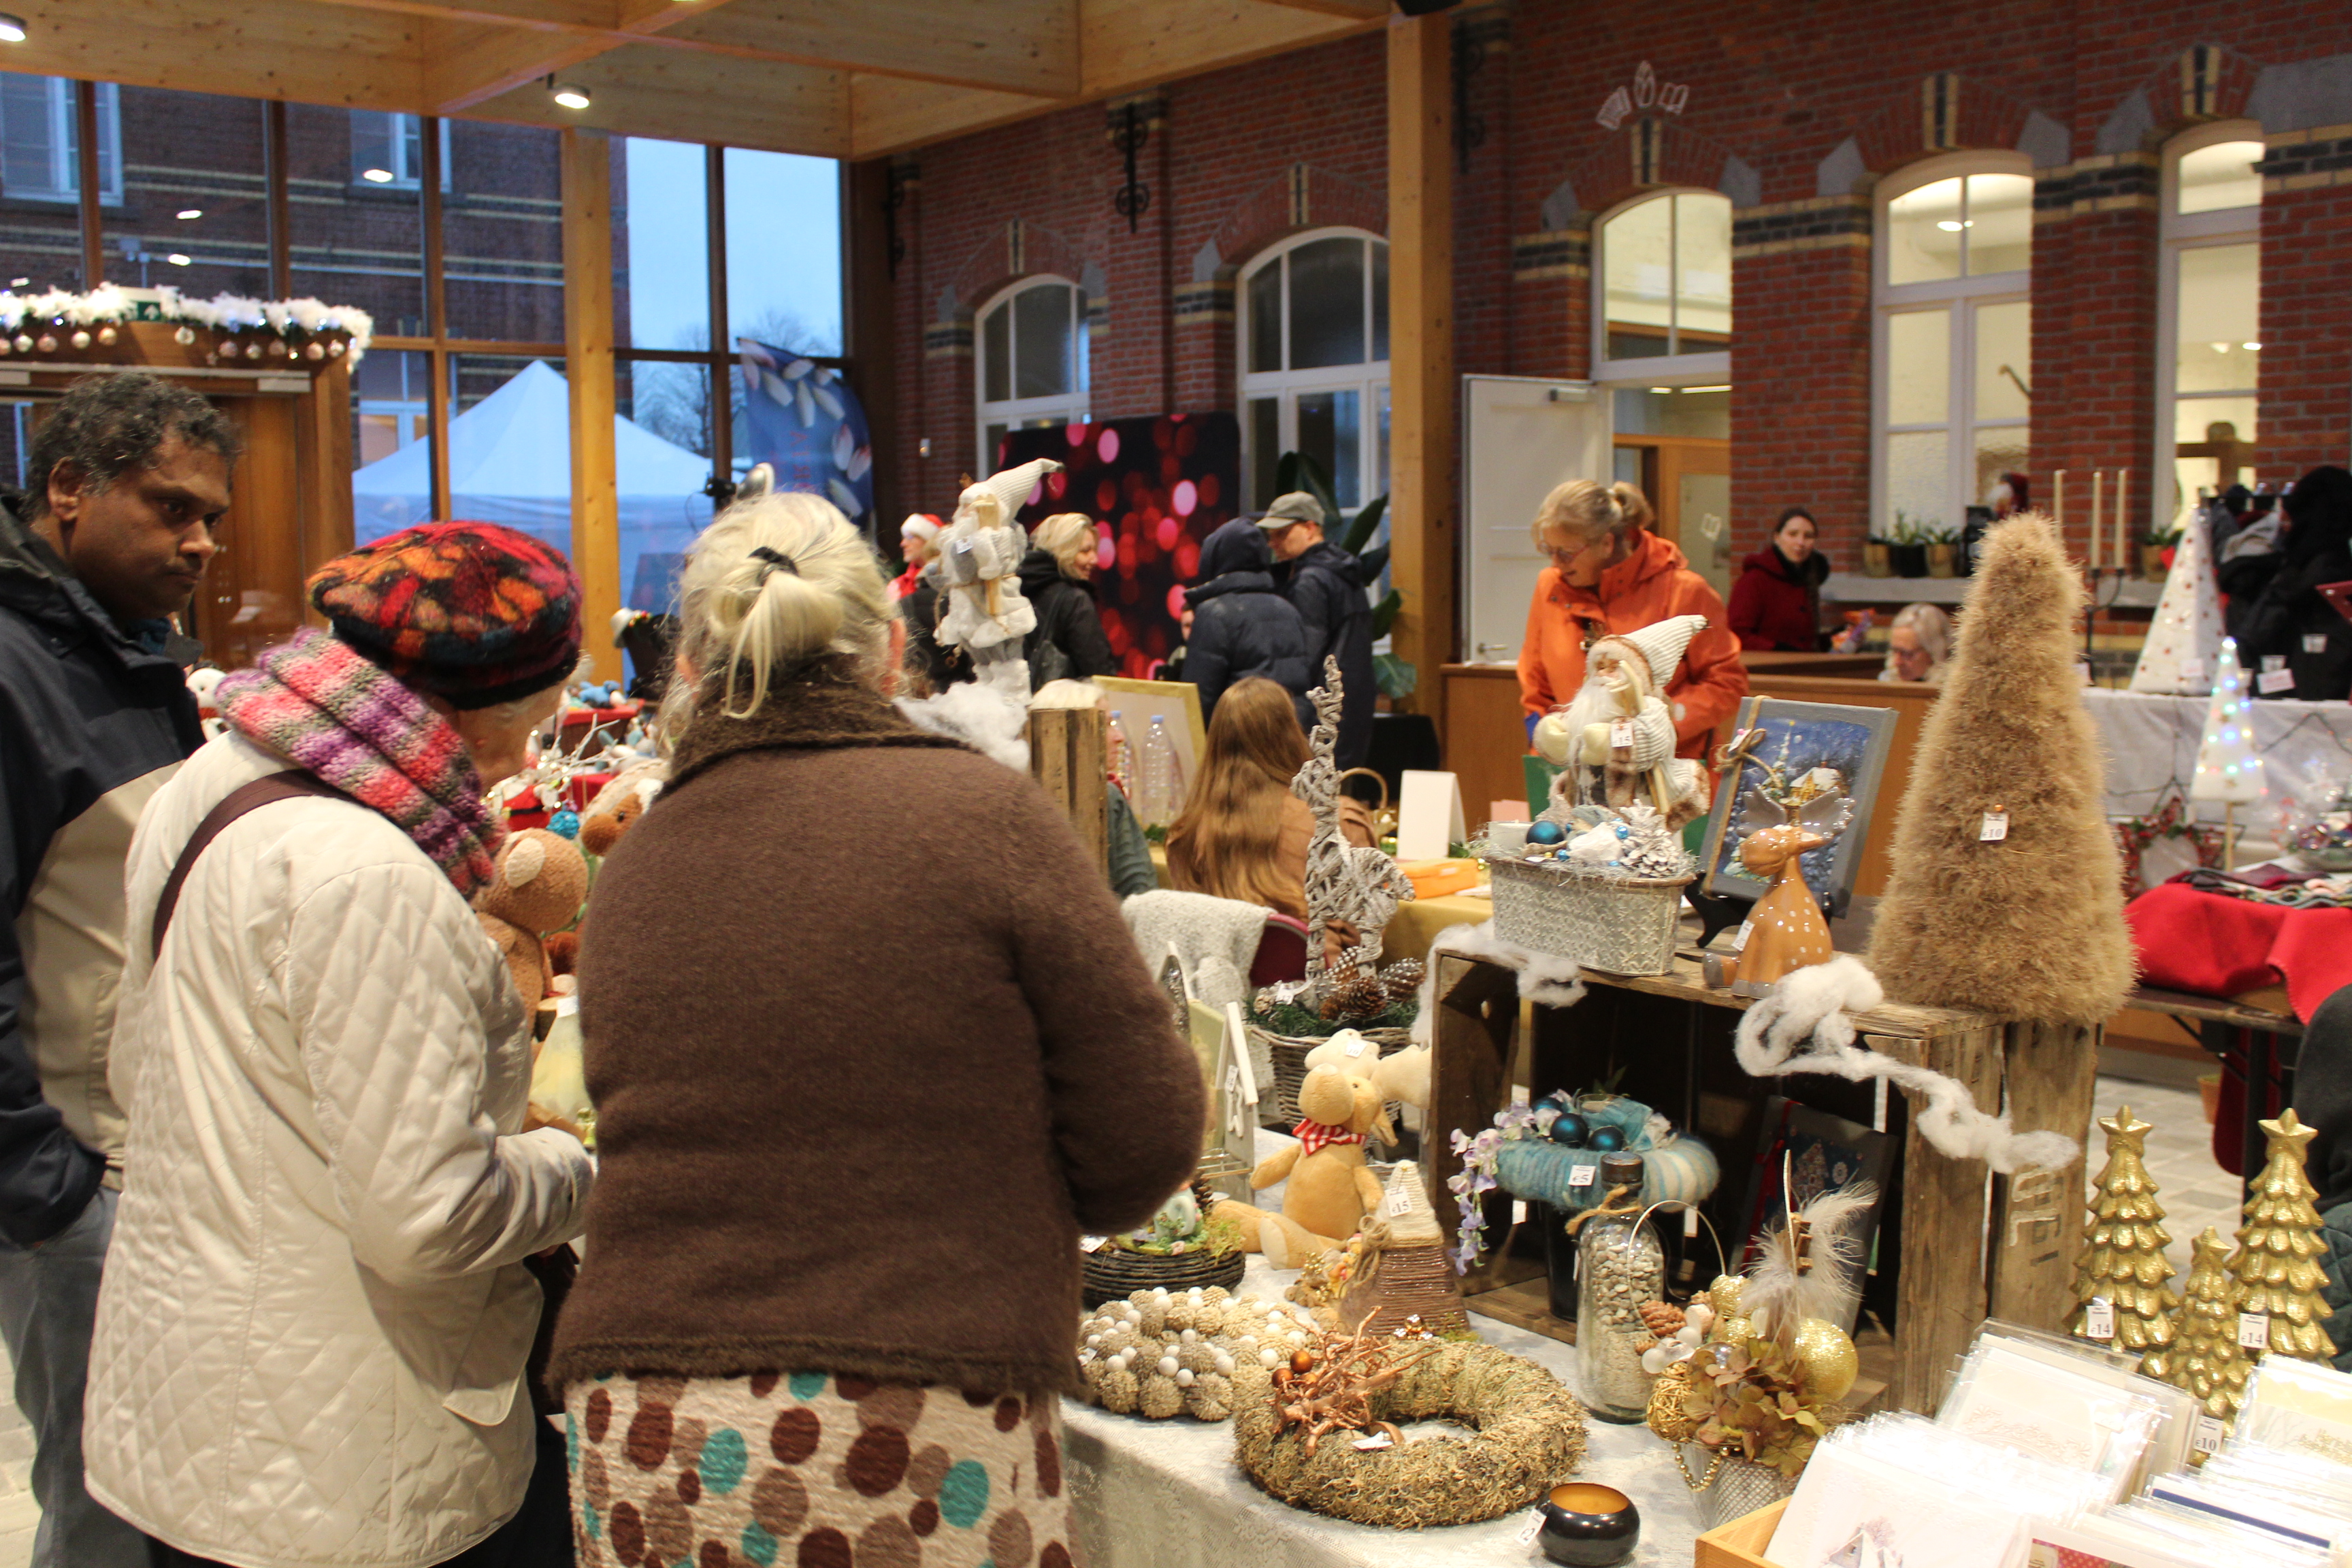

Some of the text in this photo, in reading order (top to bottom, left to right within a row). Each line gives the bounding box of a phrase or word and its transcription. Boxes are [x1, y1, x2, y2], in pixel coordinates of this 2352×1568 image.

[1392, 1200, 1409, 1213] €15
[2091, 1323, 2110, 1335] €14
[2240, 1332, 2264, 1345] €14
[2195, 1437, 2217, 1451] €10
